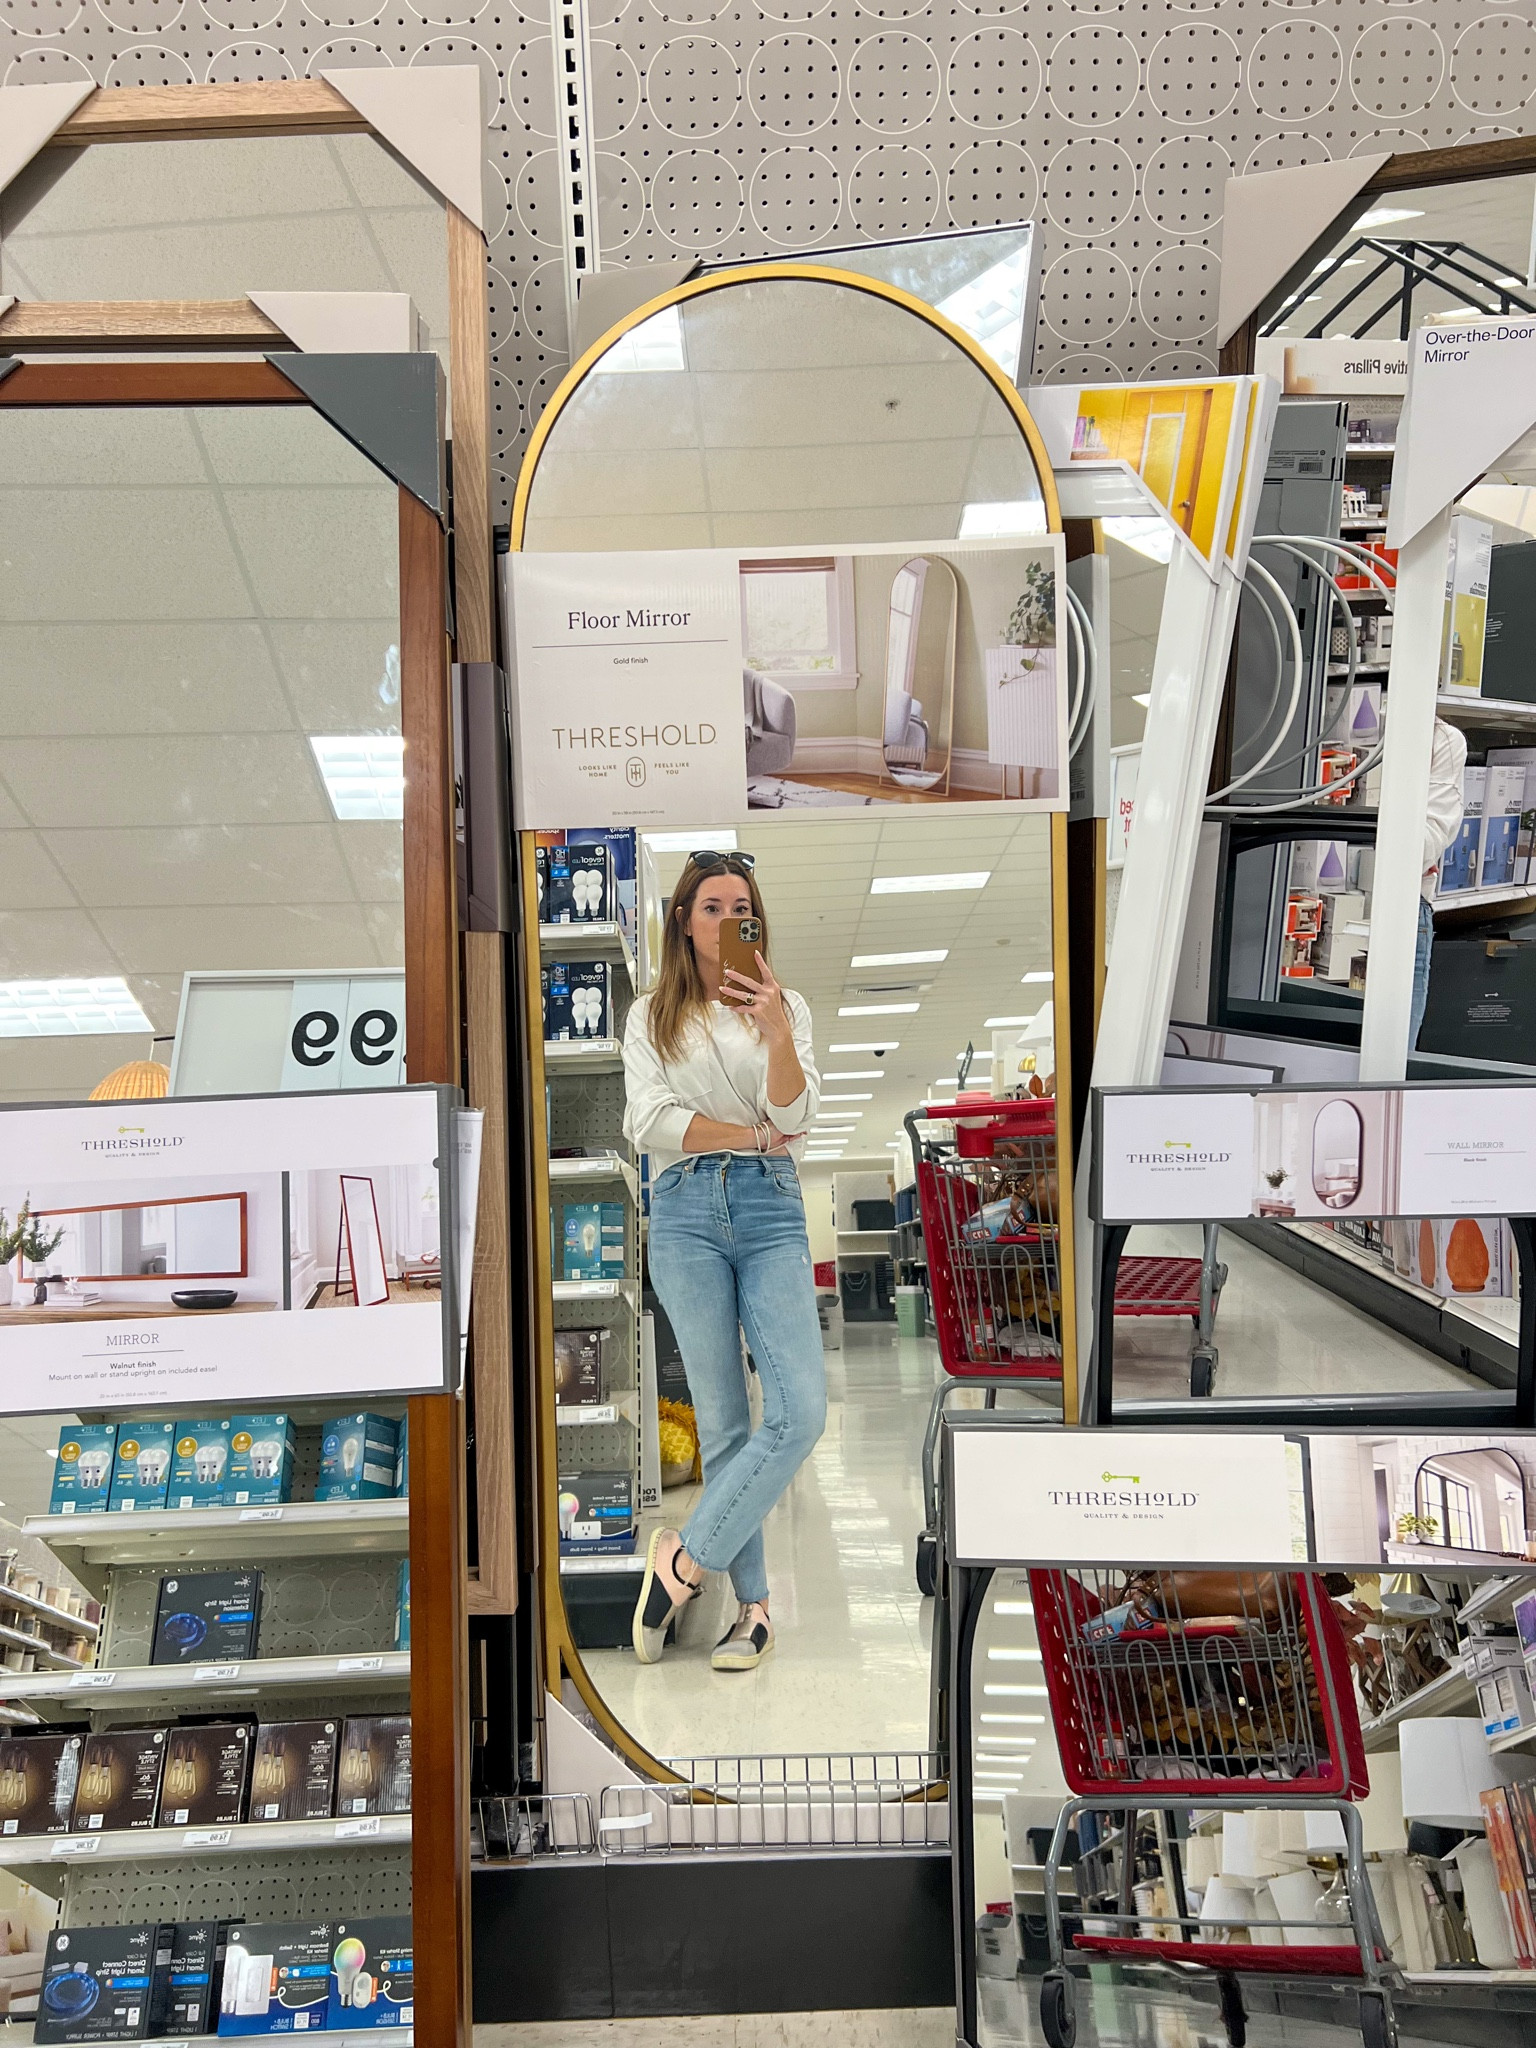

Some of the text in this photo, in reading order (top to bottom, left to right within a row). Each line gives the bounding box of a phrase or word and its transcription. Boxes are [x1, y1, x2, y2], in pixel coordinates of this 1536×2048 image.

[1426, 326, 1535, 345] Over-the-Door
[1424, 350, 1470, 363] Mirror
[568, 609, 691, 630] Floor Mirror
[552, 723, 718, 750] THRESHOLD
[82, 1137, 183, 1150] THRESHOLD
[1473, 1141, 1504, 1149] MIRROR
[1126, 1153, 1230, 1163] THRESHOLD
[106, 1333, 160, 1346] MIRROR
[137, 1360, 156, 1368] finish
[109, 1370, 128, 1378] stand
[130, 1369, 155, 1378] upright
[1048, 1492, 1197, 1506] THRESHOLD
